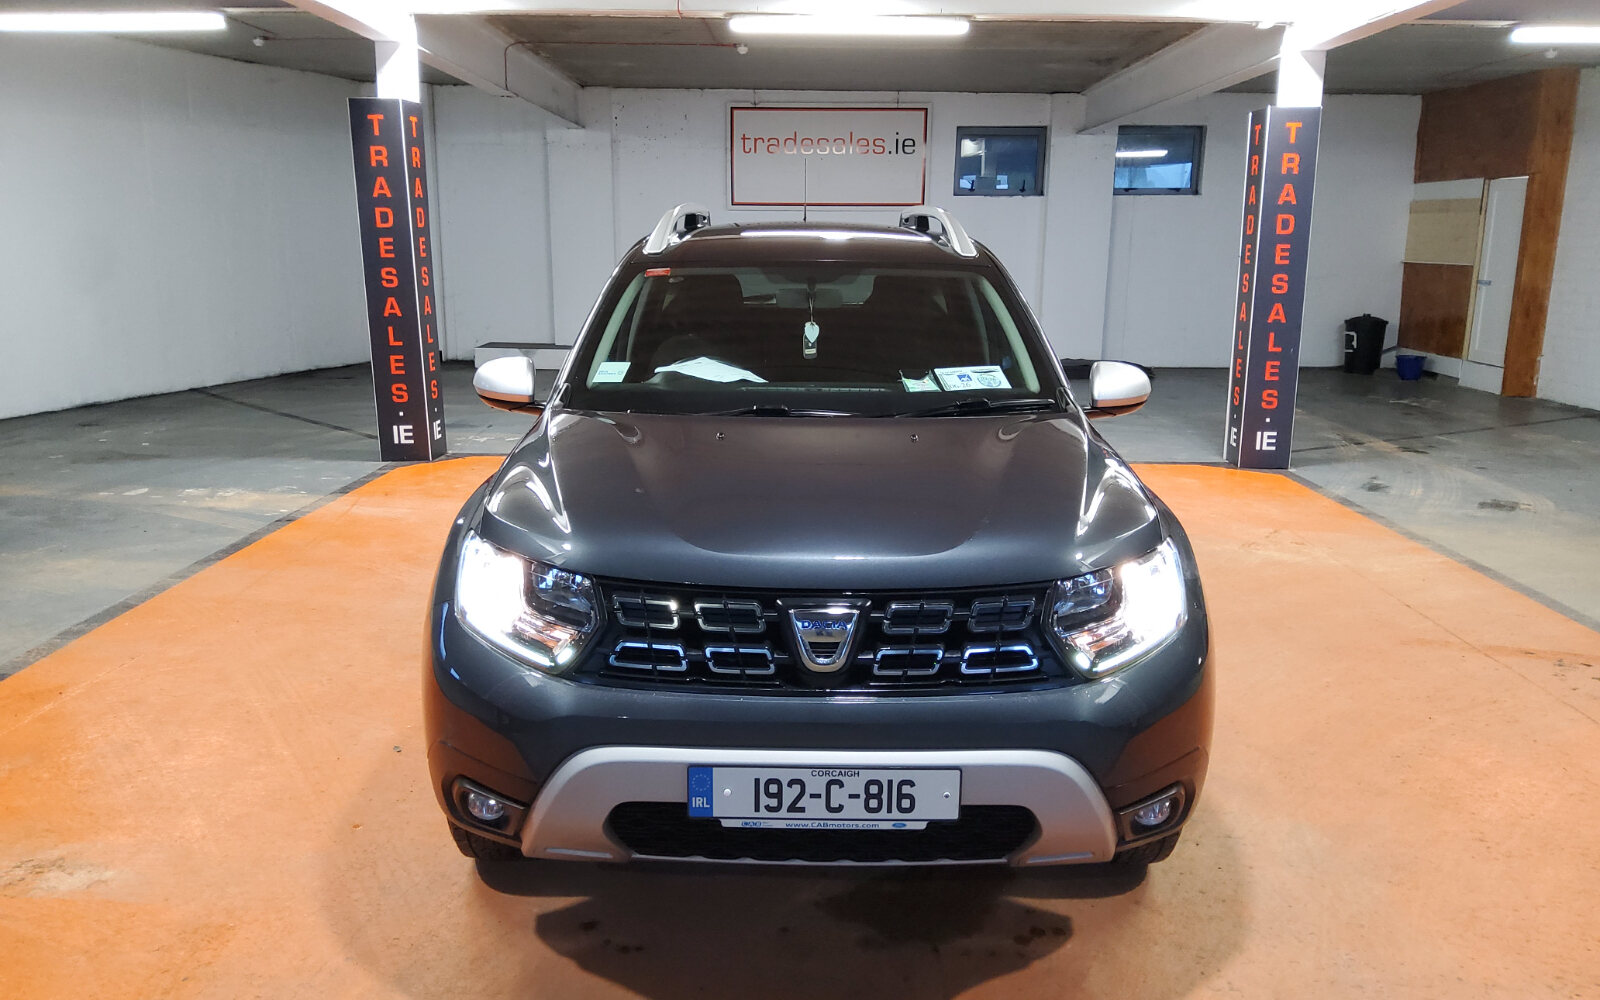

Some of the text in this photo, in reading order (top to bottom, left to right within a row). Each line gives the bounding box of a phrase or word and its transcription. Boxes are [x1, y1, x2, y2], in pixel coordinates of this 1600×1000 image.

[741, 131, 916, 155] tradesales.ie
[801, 620, 848, 629] DACIA
[811, 769, 860, 778] CORCAIGH
[754, 777, 916, 814] 192-C-816
[692, 797, 710, 808] IRL
[785, 821, 880, 829] www.CABmotors.com
